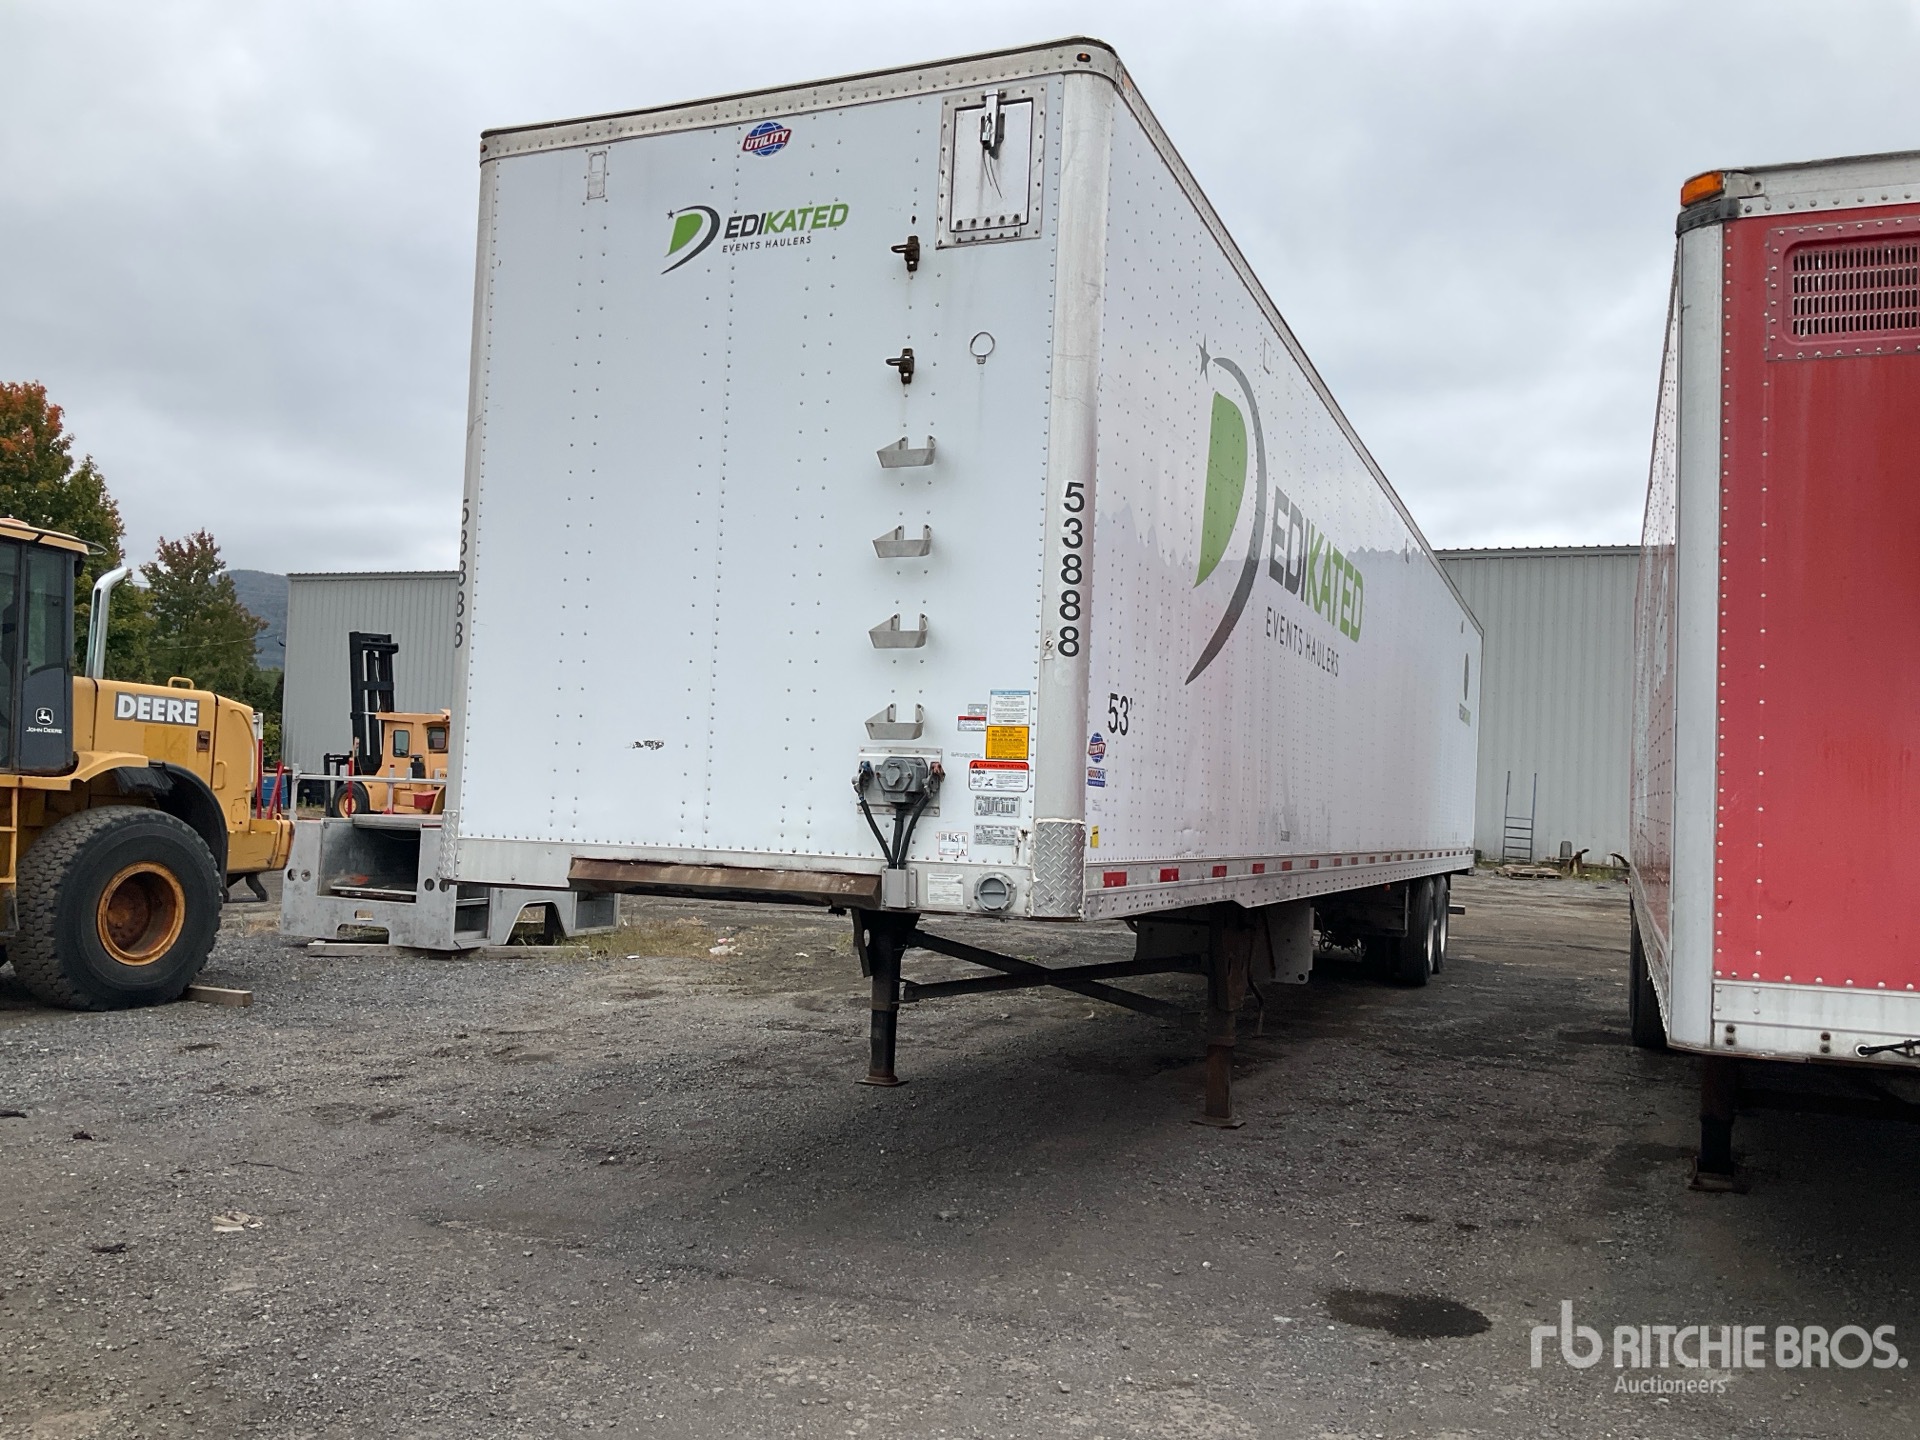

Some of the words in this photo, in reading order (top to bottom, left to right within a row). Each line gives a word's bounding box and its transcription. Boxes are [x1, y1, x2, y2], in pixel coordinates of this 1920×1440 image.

[745, 129, 790, 151] UTILITY
[722, 241, 761, 253] EVENTS
[765, 236, 812, 248] HAULERS
[1057, 481, 1085, 657] 53888
[1266, 606, 1303, 655] EVENTS
[1305, 632, 1339, 677] HAULERS
[117, 694, 198, 724] DEERE
